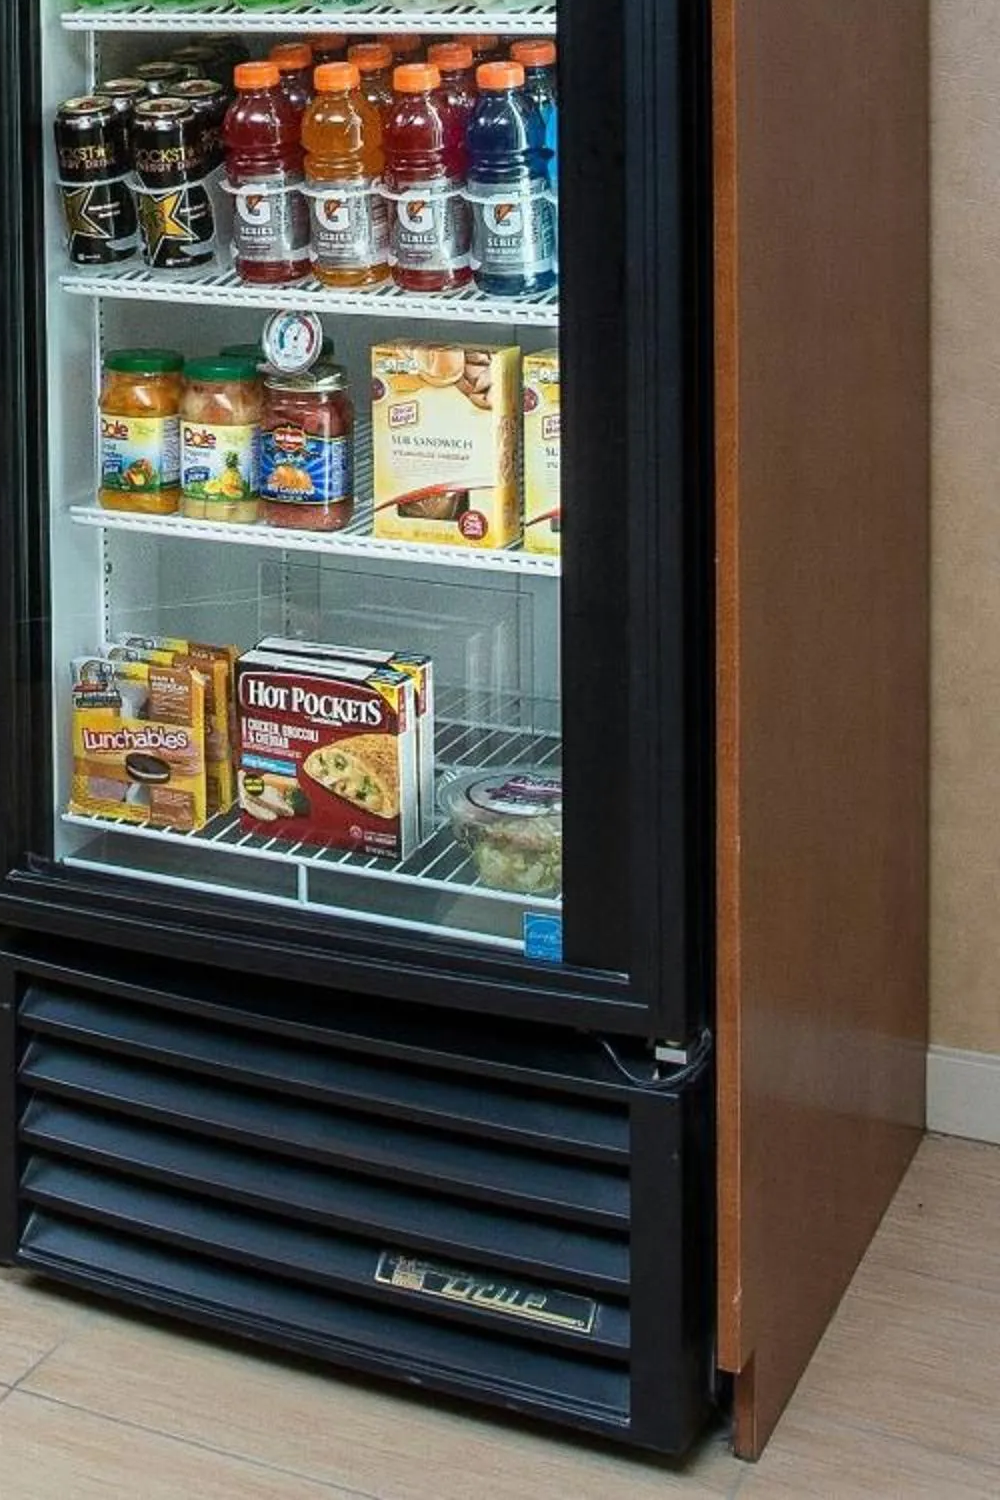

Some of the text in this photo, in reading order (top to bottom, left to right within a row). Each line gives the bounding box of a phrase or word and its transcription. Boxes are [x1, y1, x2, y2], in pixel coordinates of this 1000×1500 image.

[236, 184, 272, 226] G
[315, 190, 351, 232] G
[397, 190, 434, 233] G
[483, 193, 521, 236] G
[184, 427, 217, 448] Dole
[413, 437, 473, 450] SANDWICH
[248, 679, 383, 726] HOT POCKETS
[83, 727, 188, 750] Lunchables
